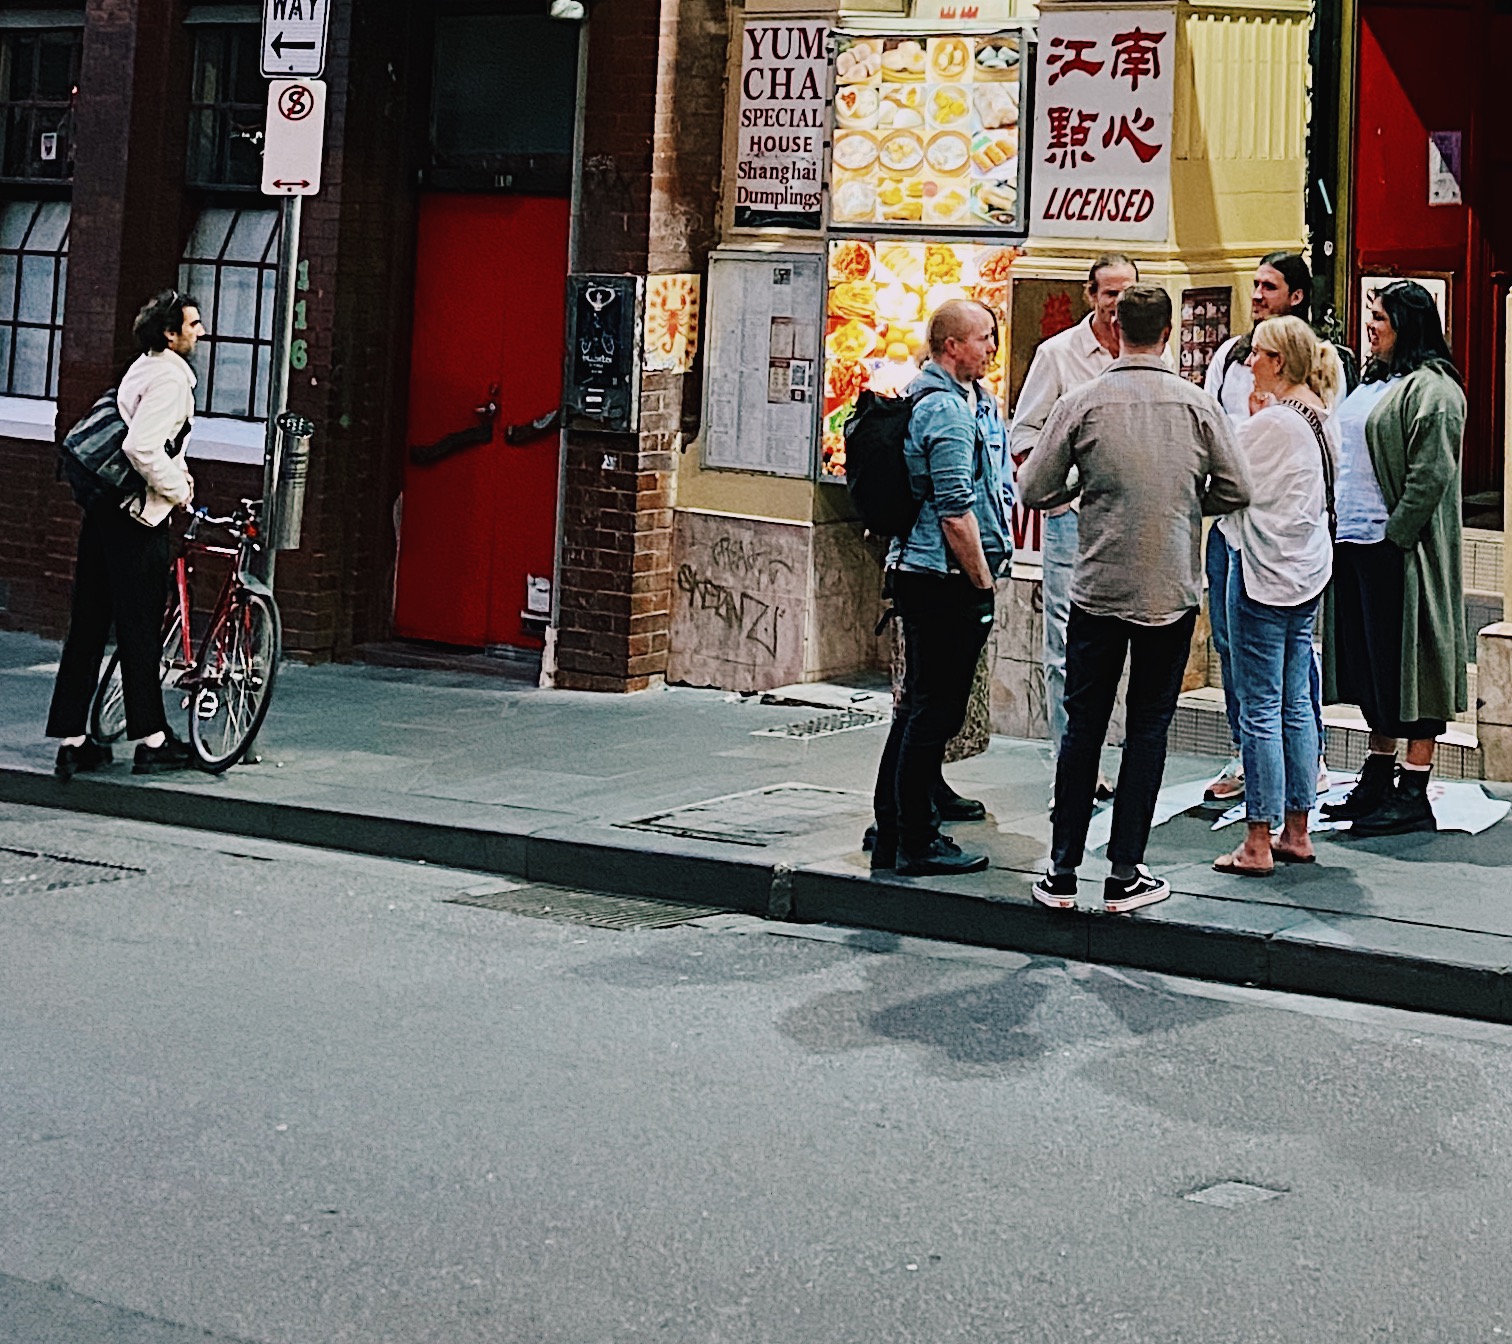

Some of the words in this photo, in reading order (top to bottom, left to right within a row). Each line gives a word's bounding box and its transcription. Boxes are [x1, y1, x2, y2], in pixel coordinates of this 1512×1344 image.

[744, 27, 827, 60] YUM
[1047, 26, 1167, 91] 江南
[743, 67, 823, 100] CHA
[741, 108, 824, 127] SPECIAL
[750, 136, 813, 152] HOUSE
[1044, 107, 1163, 169] 點心
[737, 160, 817, 184] Shanghai
[737, 185, 822, 211] Dumplings
[1043, 187, 1154, 223] LICENSED
